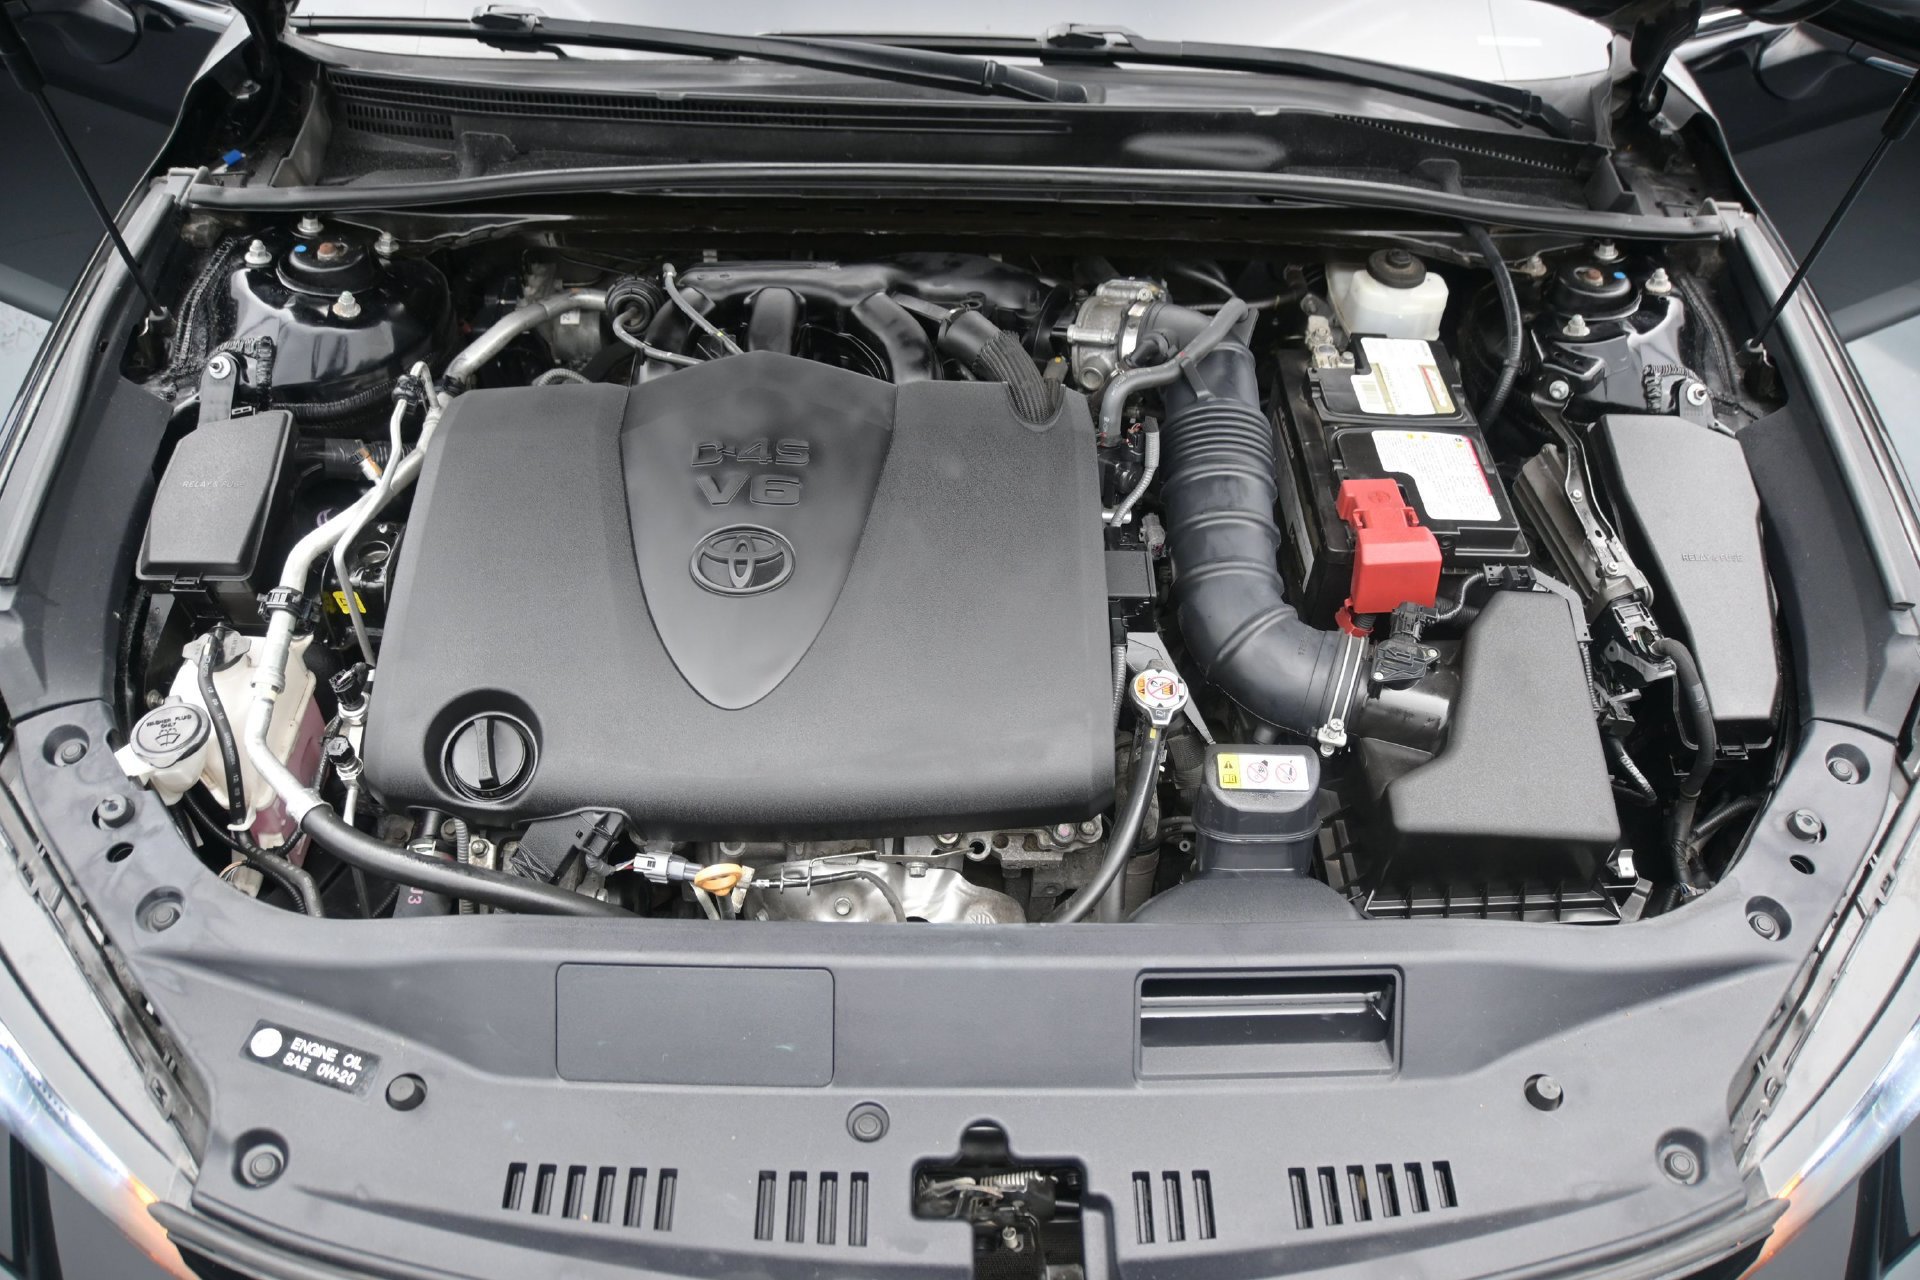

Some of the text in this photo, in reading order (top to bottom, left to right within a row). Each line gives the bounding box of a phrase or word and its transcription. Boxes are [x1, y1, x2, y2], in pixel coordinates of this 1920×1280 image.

[691, 438, 810, 467] D-4S
[695, 472, 801, 506] V6
[282, 1052, 357, 1086] SAE 0W-20
[290, 1037, 363, 1071] ENGINE OIL
